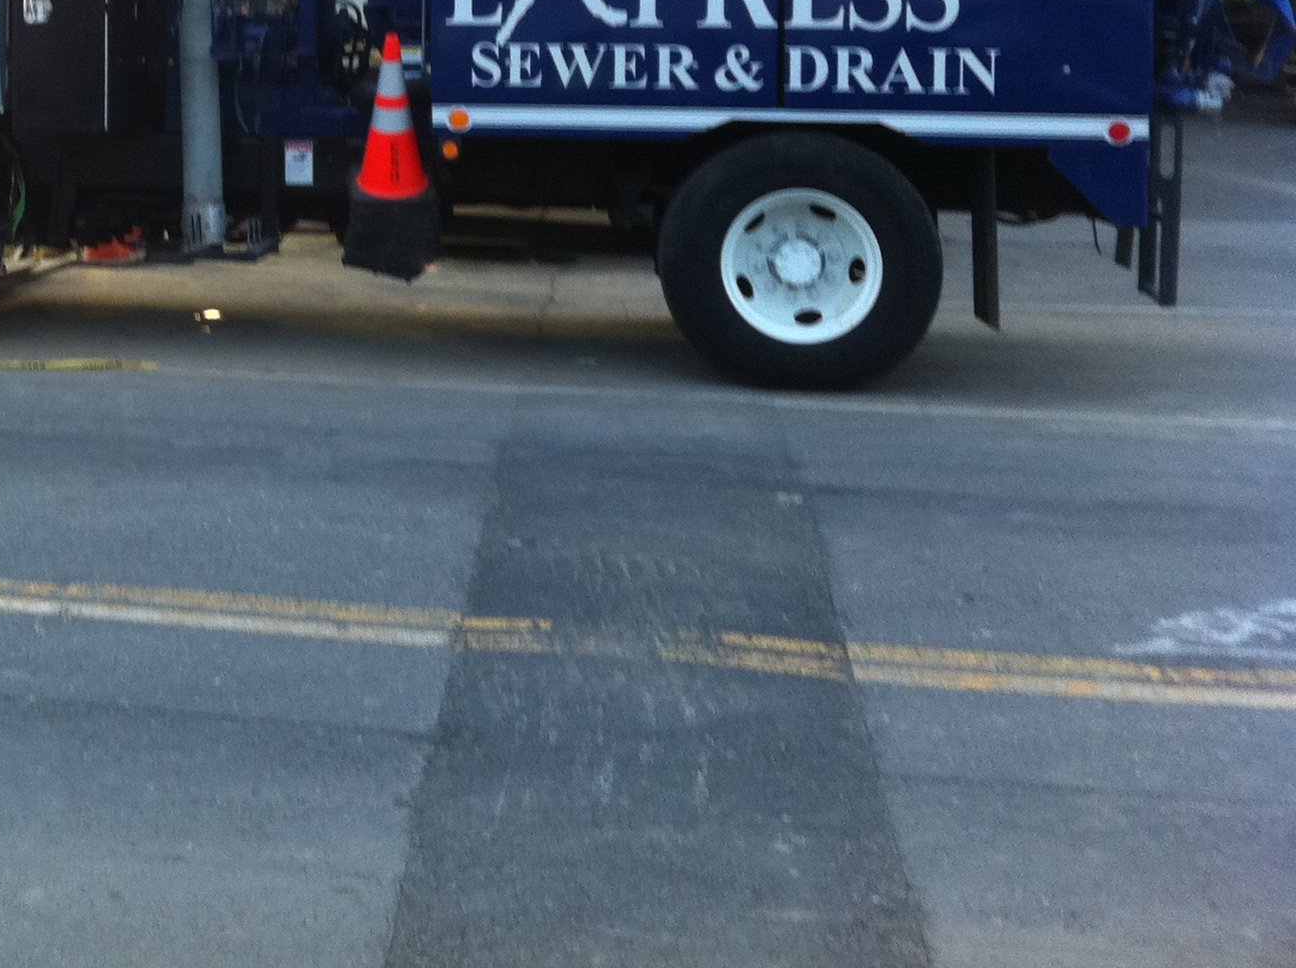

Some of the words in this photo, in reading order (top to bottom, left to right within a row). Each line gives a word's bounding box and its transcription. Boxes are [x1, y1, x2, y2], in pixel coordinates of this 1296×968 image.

[470, 40, 700, 90] SEWER
[714, 44, 764, 92] &
[784, 45, 1001, 96] DRAIN
